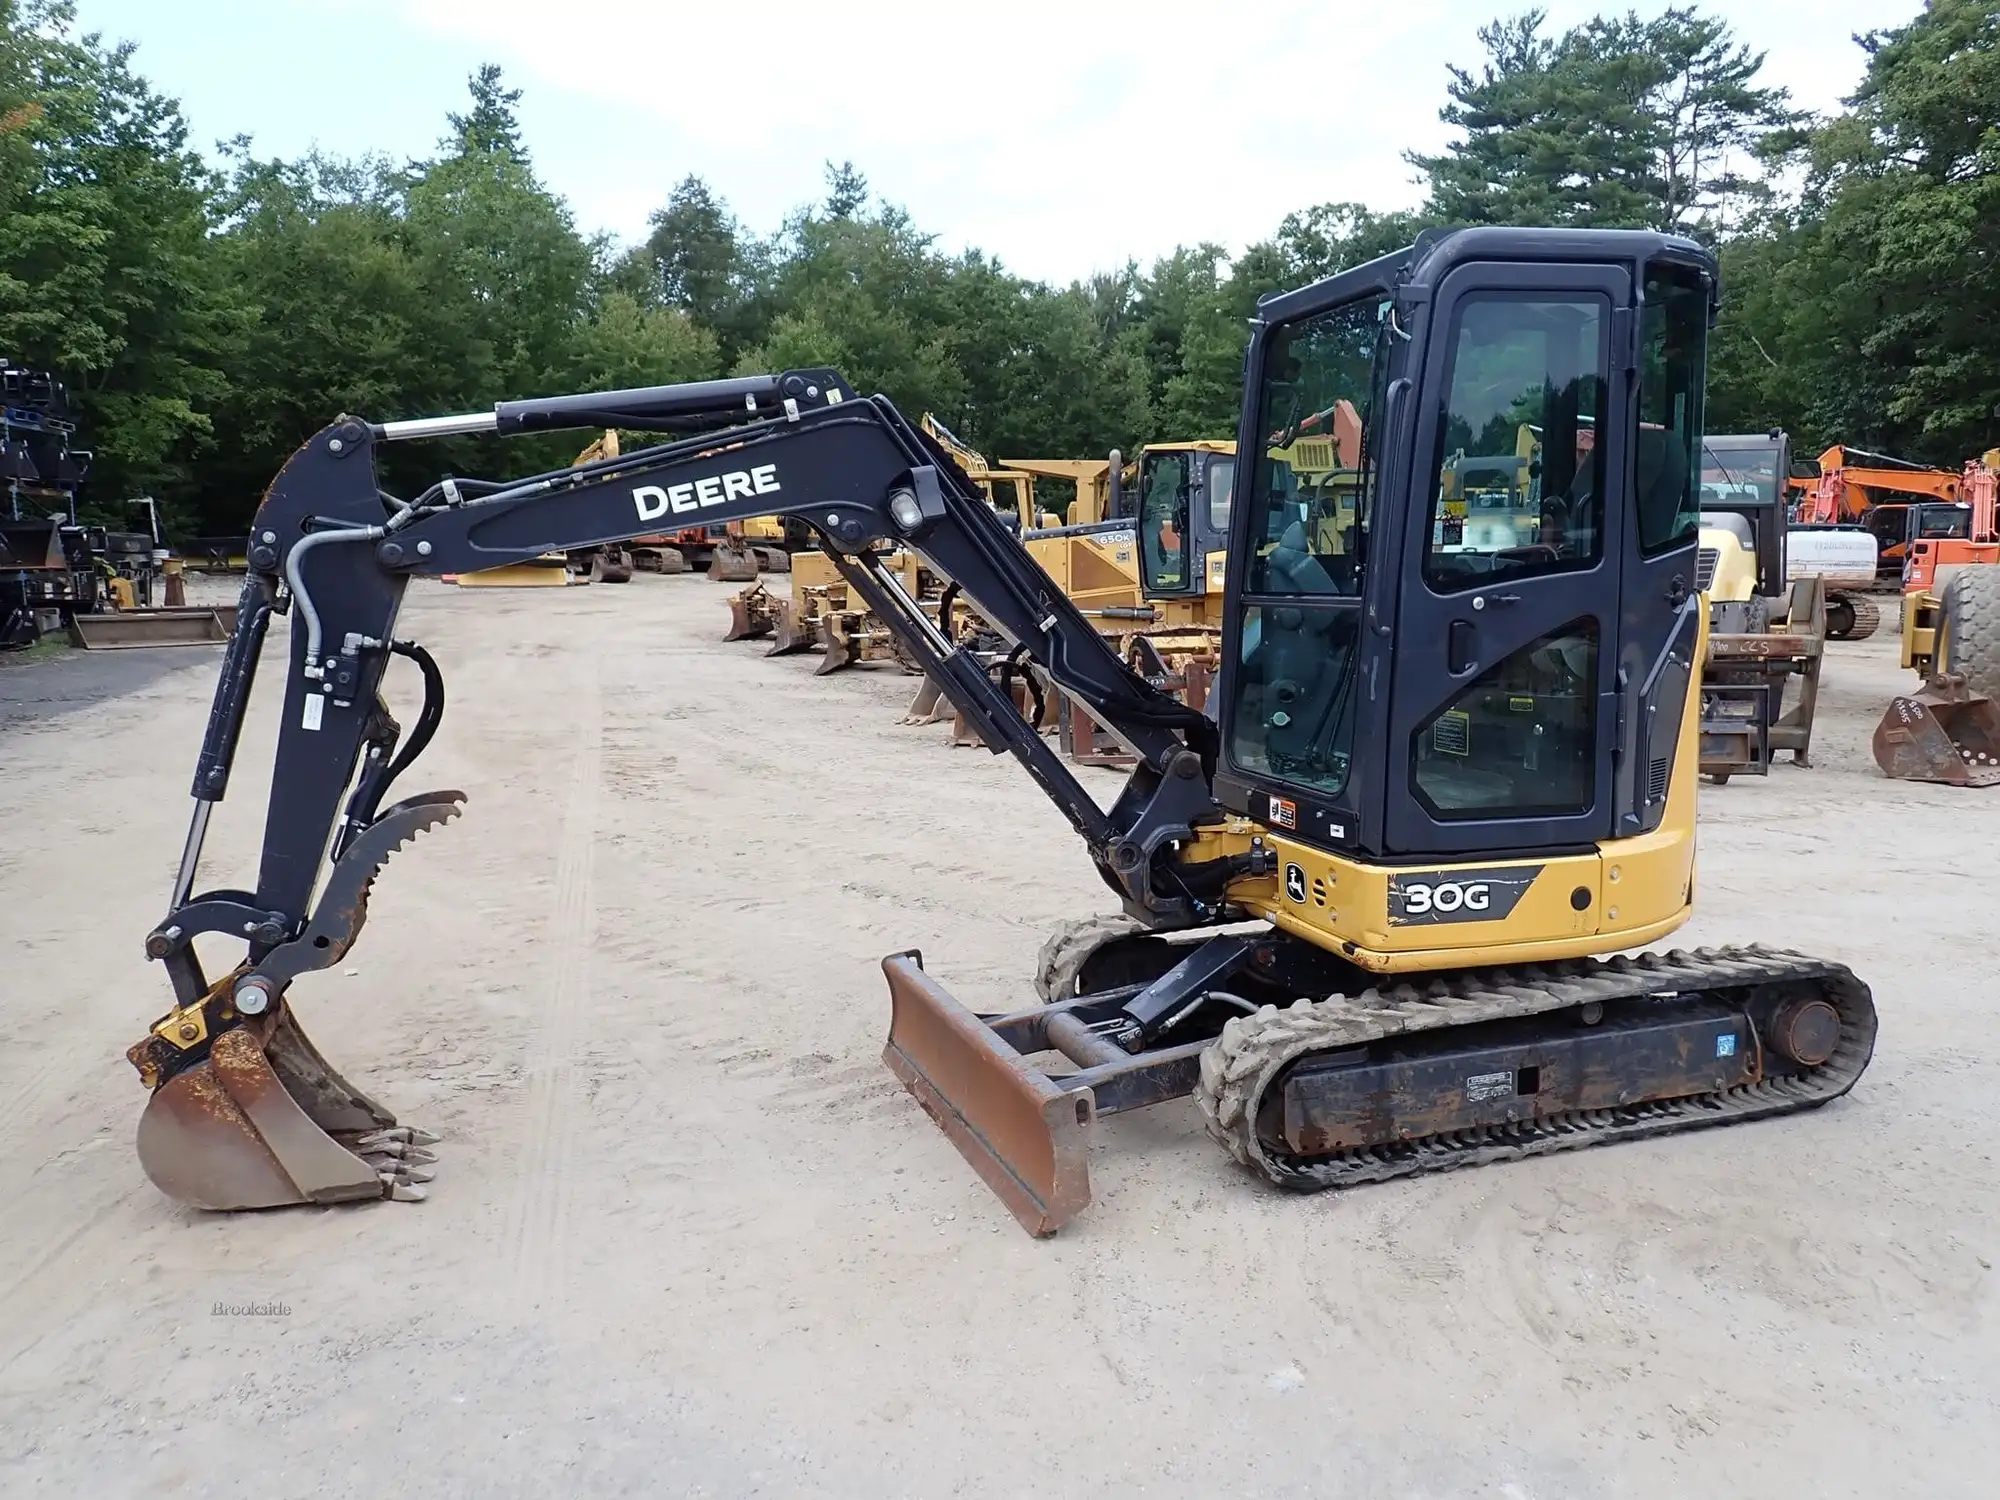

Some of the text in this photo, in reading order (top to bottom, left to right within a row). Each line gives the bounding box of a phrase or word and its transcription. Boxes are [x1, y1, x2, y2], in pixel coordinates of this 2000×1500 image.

[632, 463, 781, 521] DEERE
[1100, 534, 1131, 544] 650K
[1406, 883, 1489, 914] 30G
